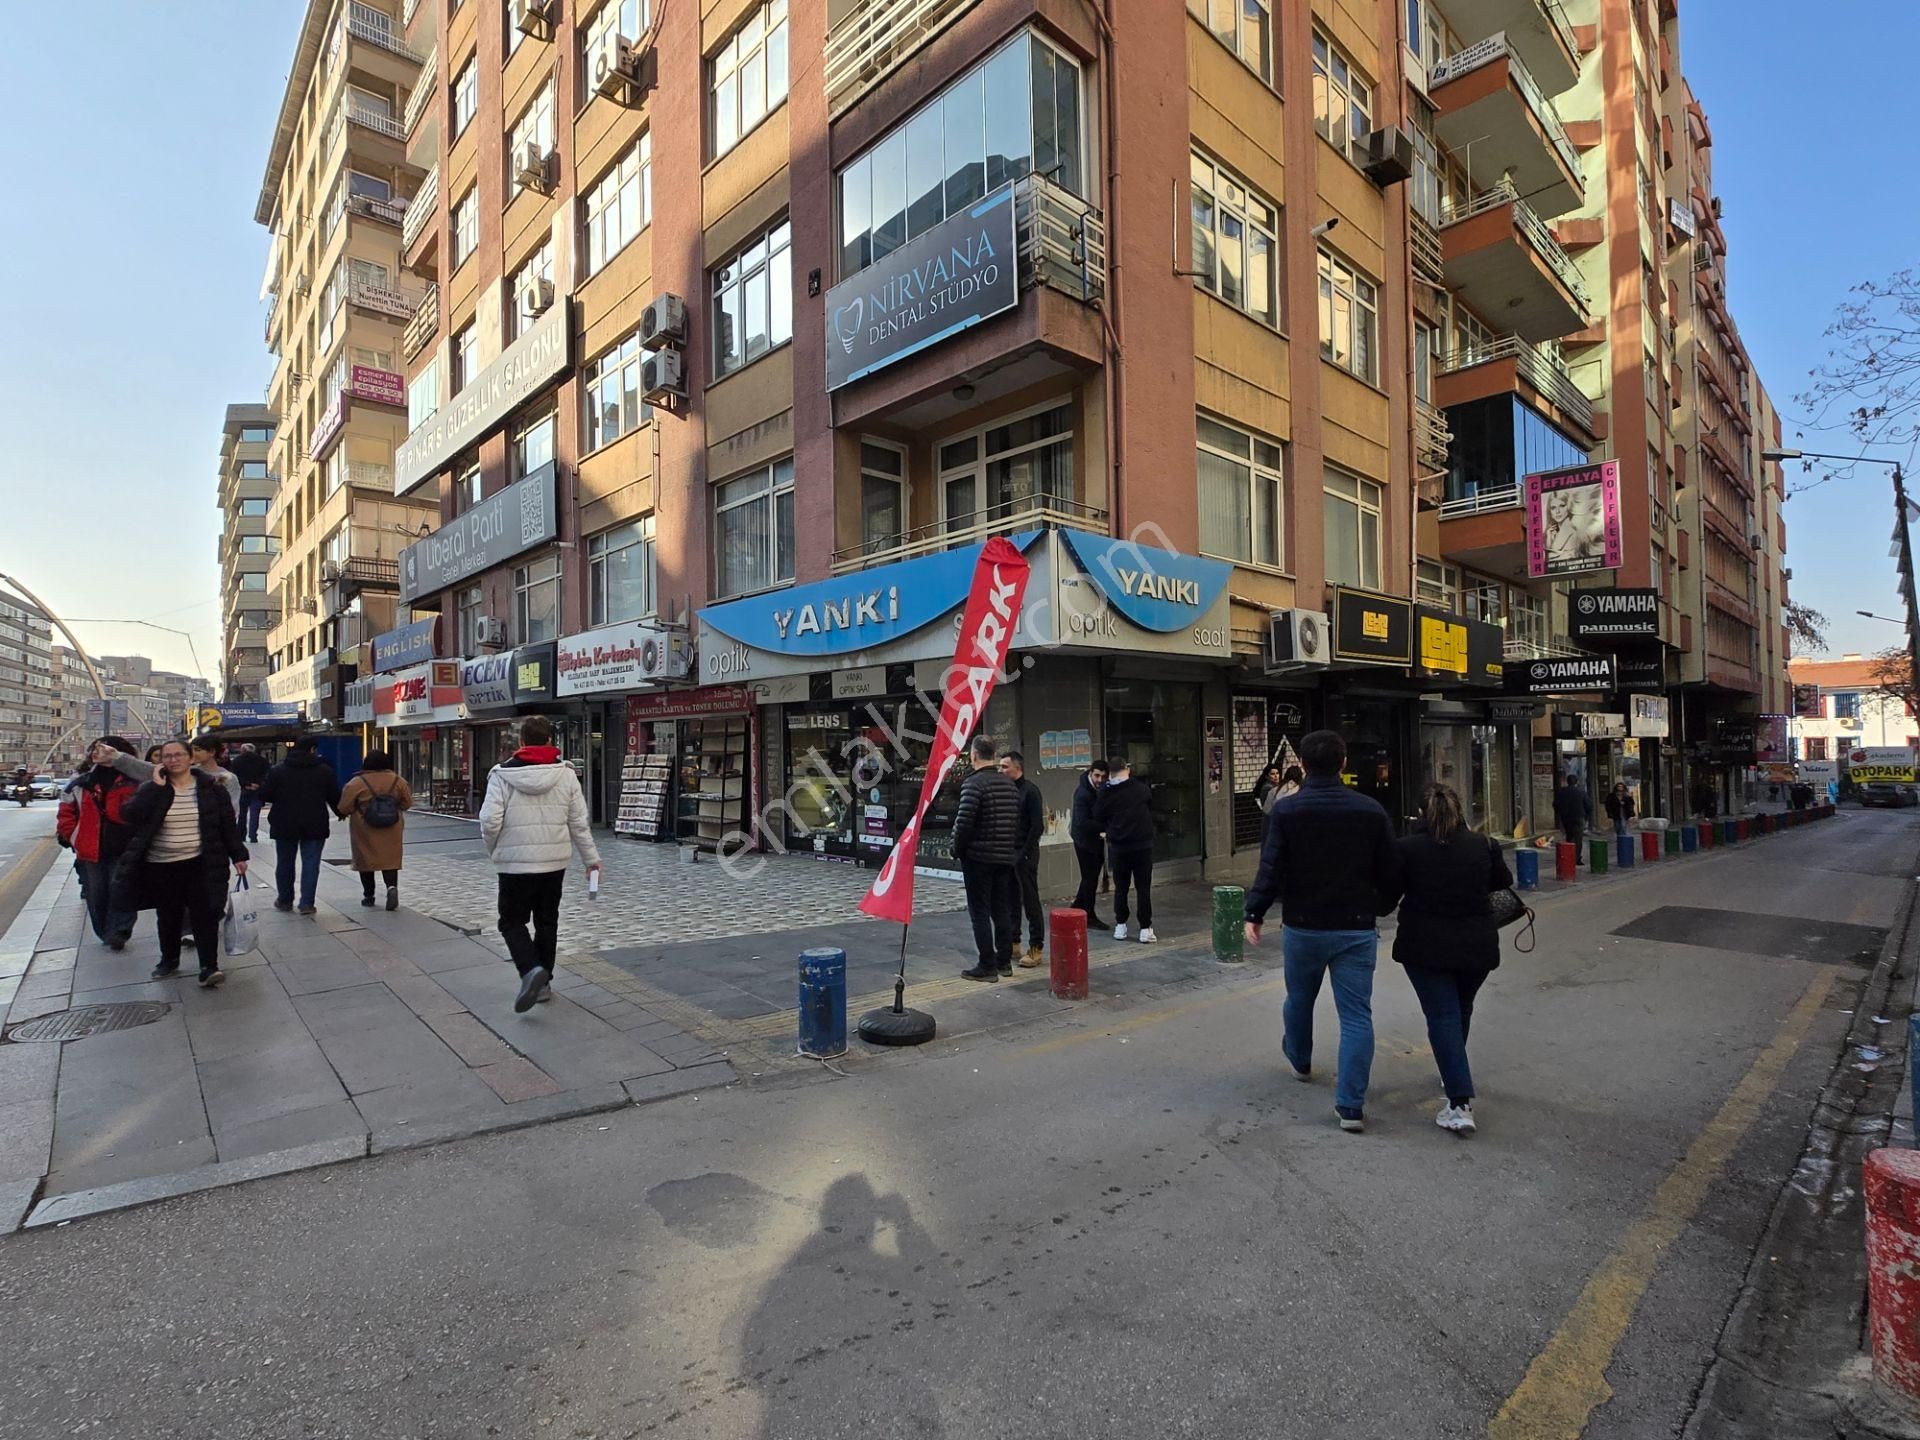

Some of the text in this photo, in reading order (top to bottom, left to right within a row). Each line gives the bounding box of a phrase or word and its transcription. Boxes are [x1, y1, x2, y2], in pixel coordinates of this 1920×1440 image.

[869, 228, 996, 322] NİRVANA
[869, 264, 998, 345] DENTAL STÜDYO
[358, 376, 398, 389] epilasyon
[386, 373, 399, 383] life
[446, 373, 501, 438] GÜZELLİK
[503, 317, 562, 391] SALONU
[1543, 470, 1601, 488] EFTALYA
[1530, 481, 1542, 572] COIFFEUR
[1606, 467, 1618, 561] COIFFEUR
[426, 499, 503, 570] Liberal Parti
[442, 547, 486, 582] Genel Merkezi
[1117, 568, 1200, 606] YANKI
[1597, 595, 1657, 613] YAMAHA
[1069, 610, 1226, 648] optik saat
[1579, 622, 1656, 634] panmusic
[376, 632, 432, 660] ENGLISH
[464, 657, 509, 686] ECEM
[709, 643, 750, 680] optik
[1549, 660, 1610, 677] YAMAHA
[468, 687, 506, 705] OPTİK
[1529, 680, 1611, 692] panmusic
[713, 700, 740, 710] DOLUMU
[810, 715, 840, 728] LENS
[1852, 766, 1913, 778] OTOPARK
